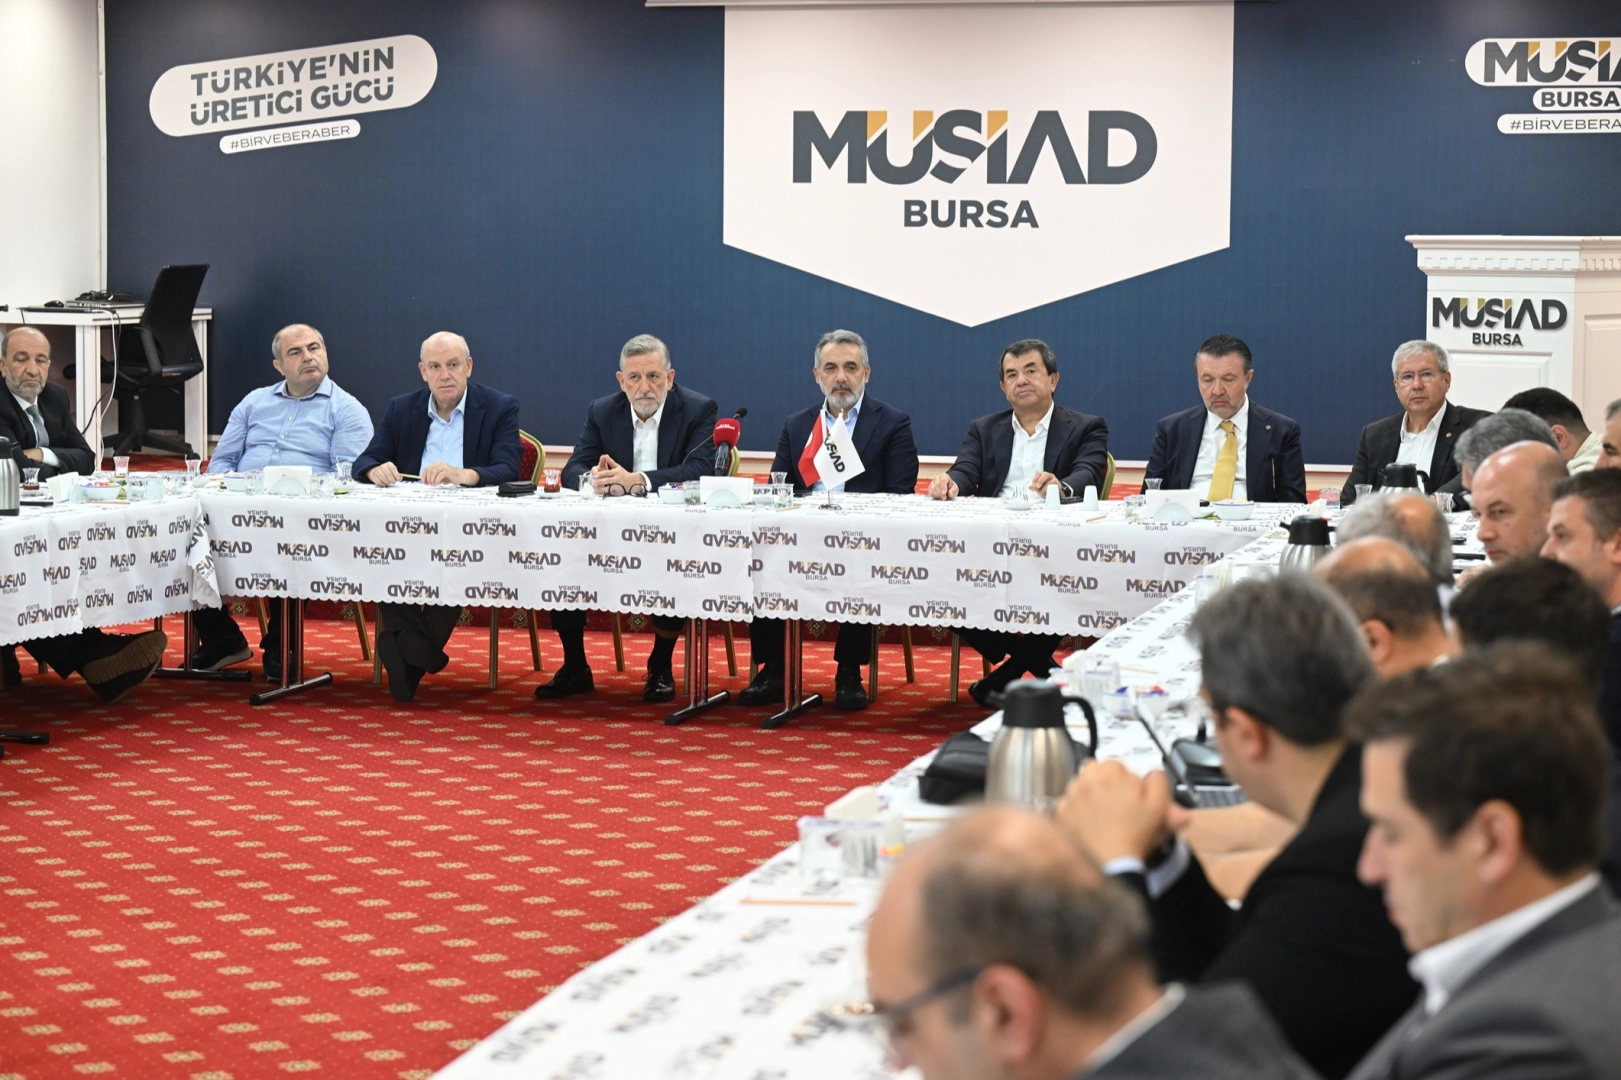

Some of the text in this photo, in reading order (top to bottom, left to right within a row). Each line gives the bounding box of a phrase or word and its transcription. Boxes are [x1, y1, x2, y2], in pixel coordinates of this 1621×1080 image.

[191, 46, 394, 96] TÜRKİYE'NİN
[191, 76, 394, 126] ÜRETİCİ GÜCÜ
[1541, 91, 1620, 107] BURSA
[1510, 117, 1621, 130] #BİRVEBERA
[904, 200, 1039, 228] BURSA
[1472, 332, 1522, 346] BURSA
